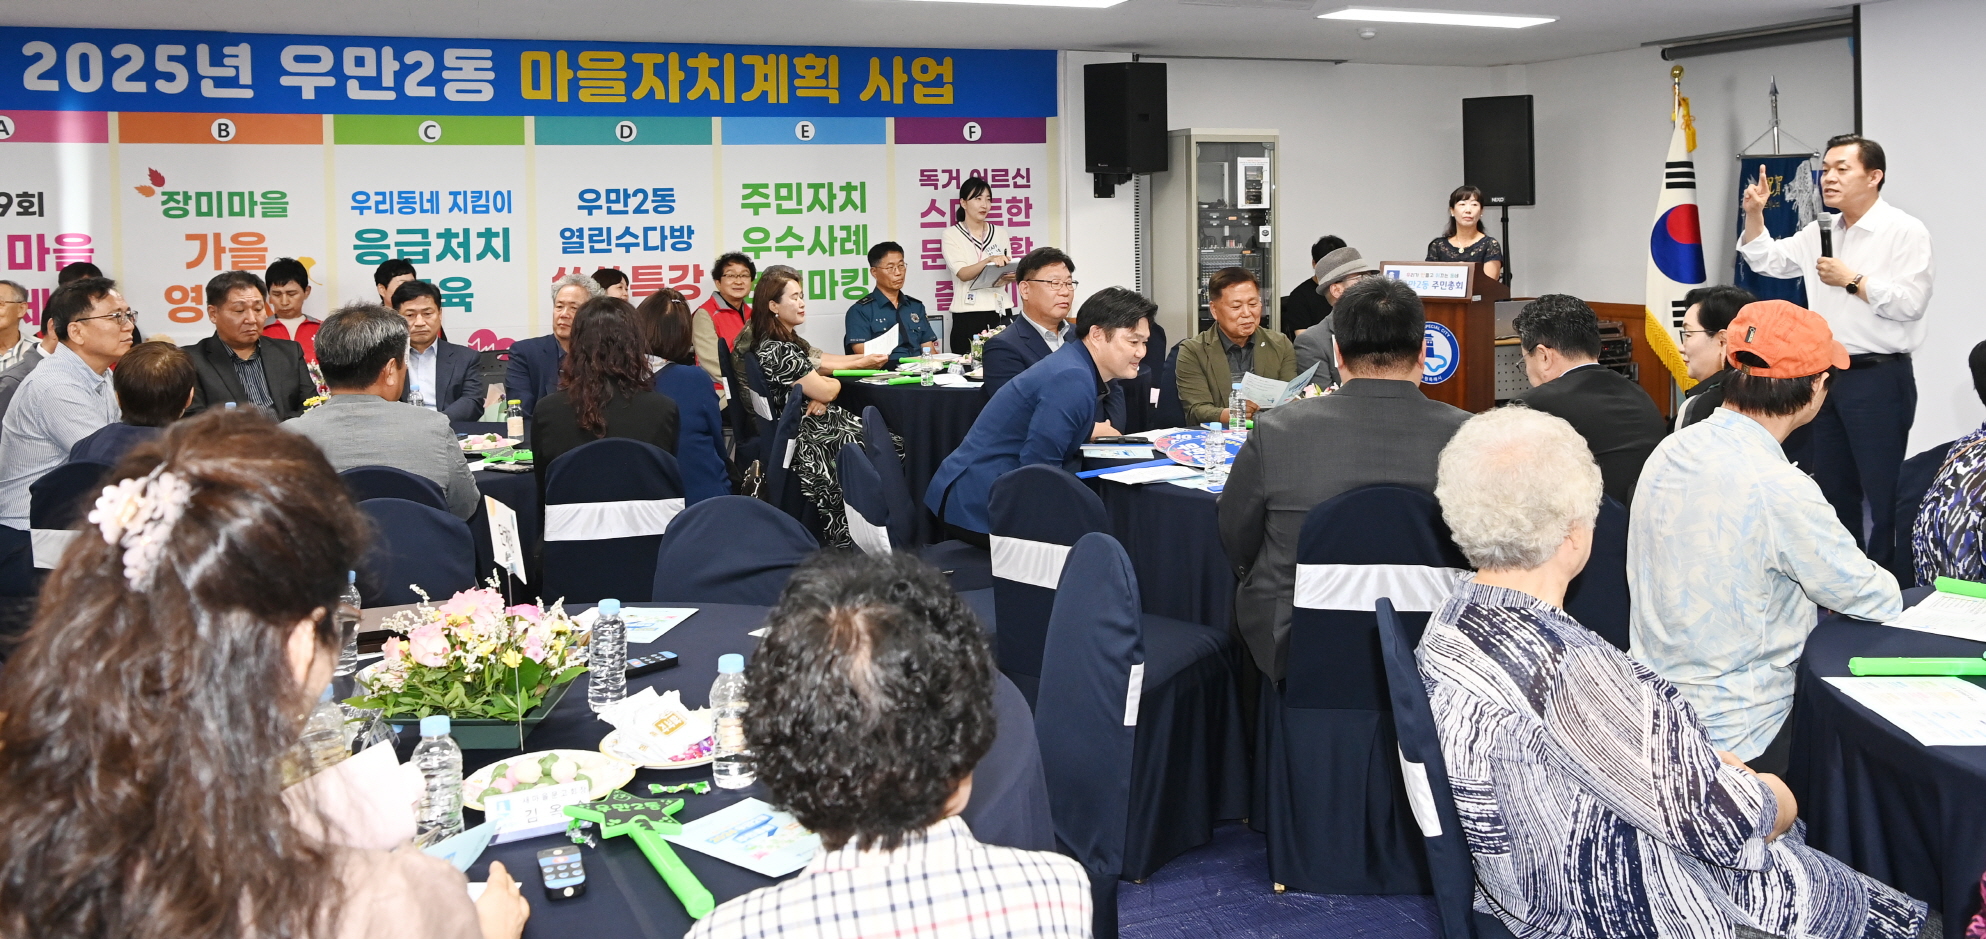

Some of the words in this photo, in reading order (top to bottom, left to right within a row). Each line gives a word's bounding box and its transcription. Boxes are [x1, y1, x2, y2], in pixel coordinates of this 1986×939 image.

[22, 41, 254, 99] 2025년
[279, 45, 496, 102] 우만2동
[520, 49, 840, 105] 마을자치계획
[860, 55, 954, 105] 사업
[217, 123, 229, 139] B
[424, 124, 436, 140] C
[621, 124, 633, 139] D
[801, 124, 809, 138] E
[968, 125, 977, 138] F
[919, 168, 961, 190] 독거
[161, 190, 289, 219] 장미마을
[350, 190, 440, 215] 우리동네
[448, 190, 512, 215] 지킴이
[577, 188, 676, 216] 우만2동
[741, 181, 867, 216] 주민자치
[7, 233, 95, 272] 마을
[185, 231, 269, 271] 가을
[353, 227, 511, 265] 응급처치
[559, 225, 695, 255] 열린수다방
[741, 224, 868, 260] 우수사례
[552, 264, 705, 300] 특강
[745, 267, 870, 303] 마킹
[1406, 280, 1430, 290] 만2동
[1431, 280, 1464, 291] 주민총회
[1424, 323, 1441, 332] PECIAL
[1440, 327, 1451, 338] CITY
[595, 801, 661, 813] 우만2동
